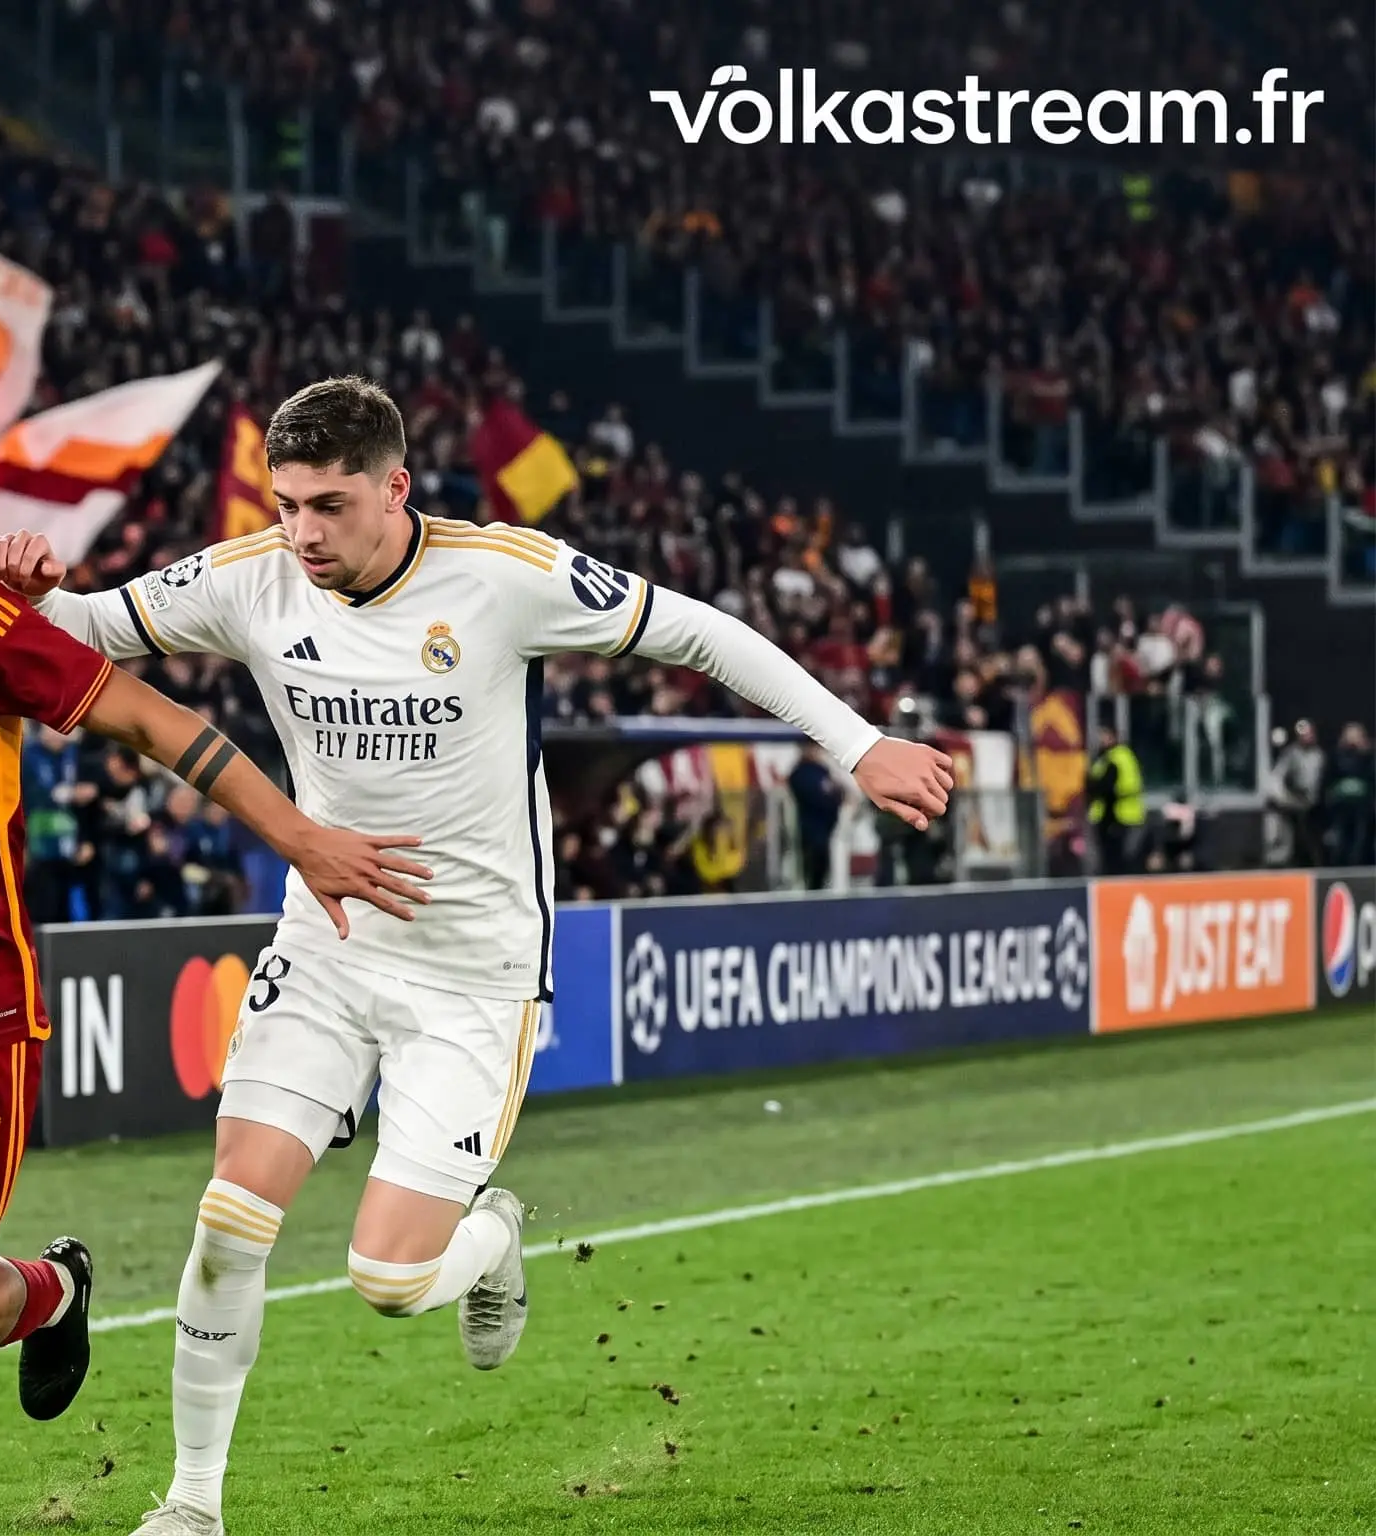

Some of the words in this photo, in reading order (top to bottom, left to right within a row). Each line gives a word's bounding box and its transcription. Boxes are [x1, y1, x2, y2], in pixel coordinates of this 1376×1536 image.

[284, 683, 464, 727] Emirates
[315, 729, 348, 759] FLY
[356, 732, 437, 761] BETTER
[675, 945, 764, 1032] UEFA
[767, 932, 944, 1025] CHAMPIONS
[949, 924, 1054, 1008] LEAGUE
[1161, 901, 1233, 1012] JUST
[1236, 898, 1293, 990] EAT
[61, 973, 123, 1099] IN
